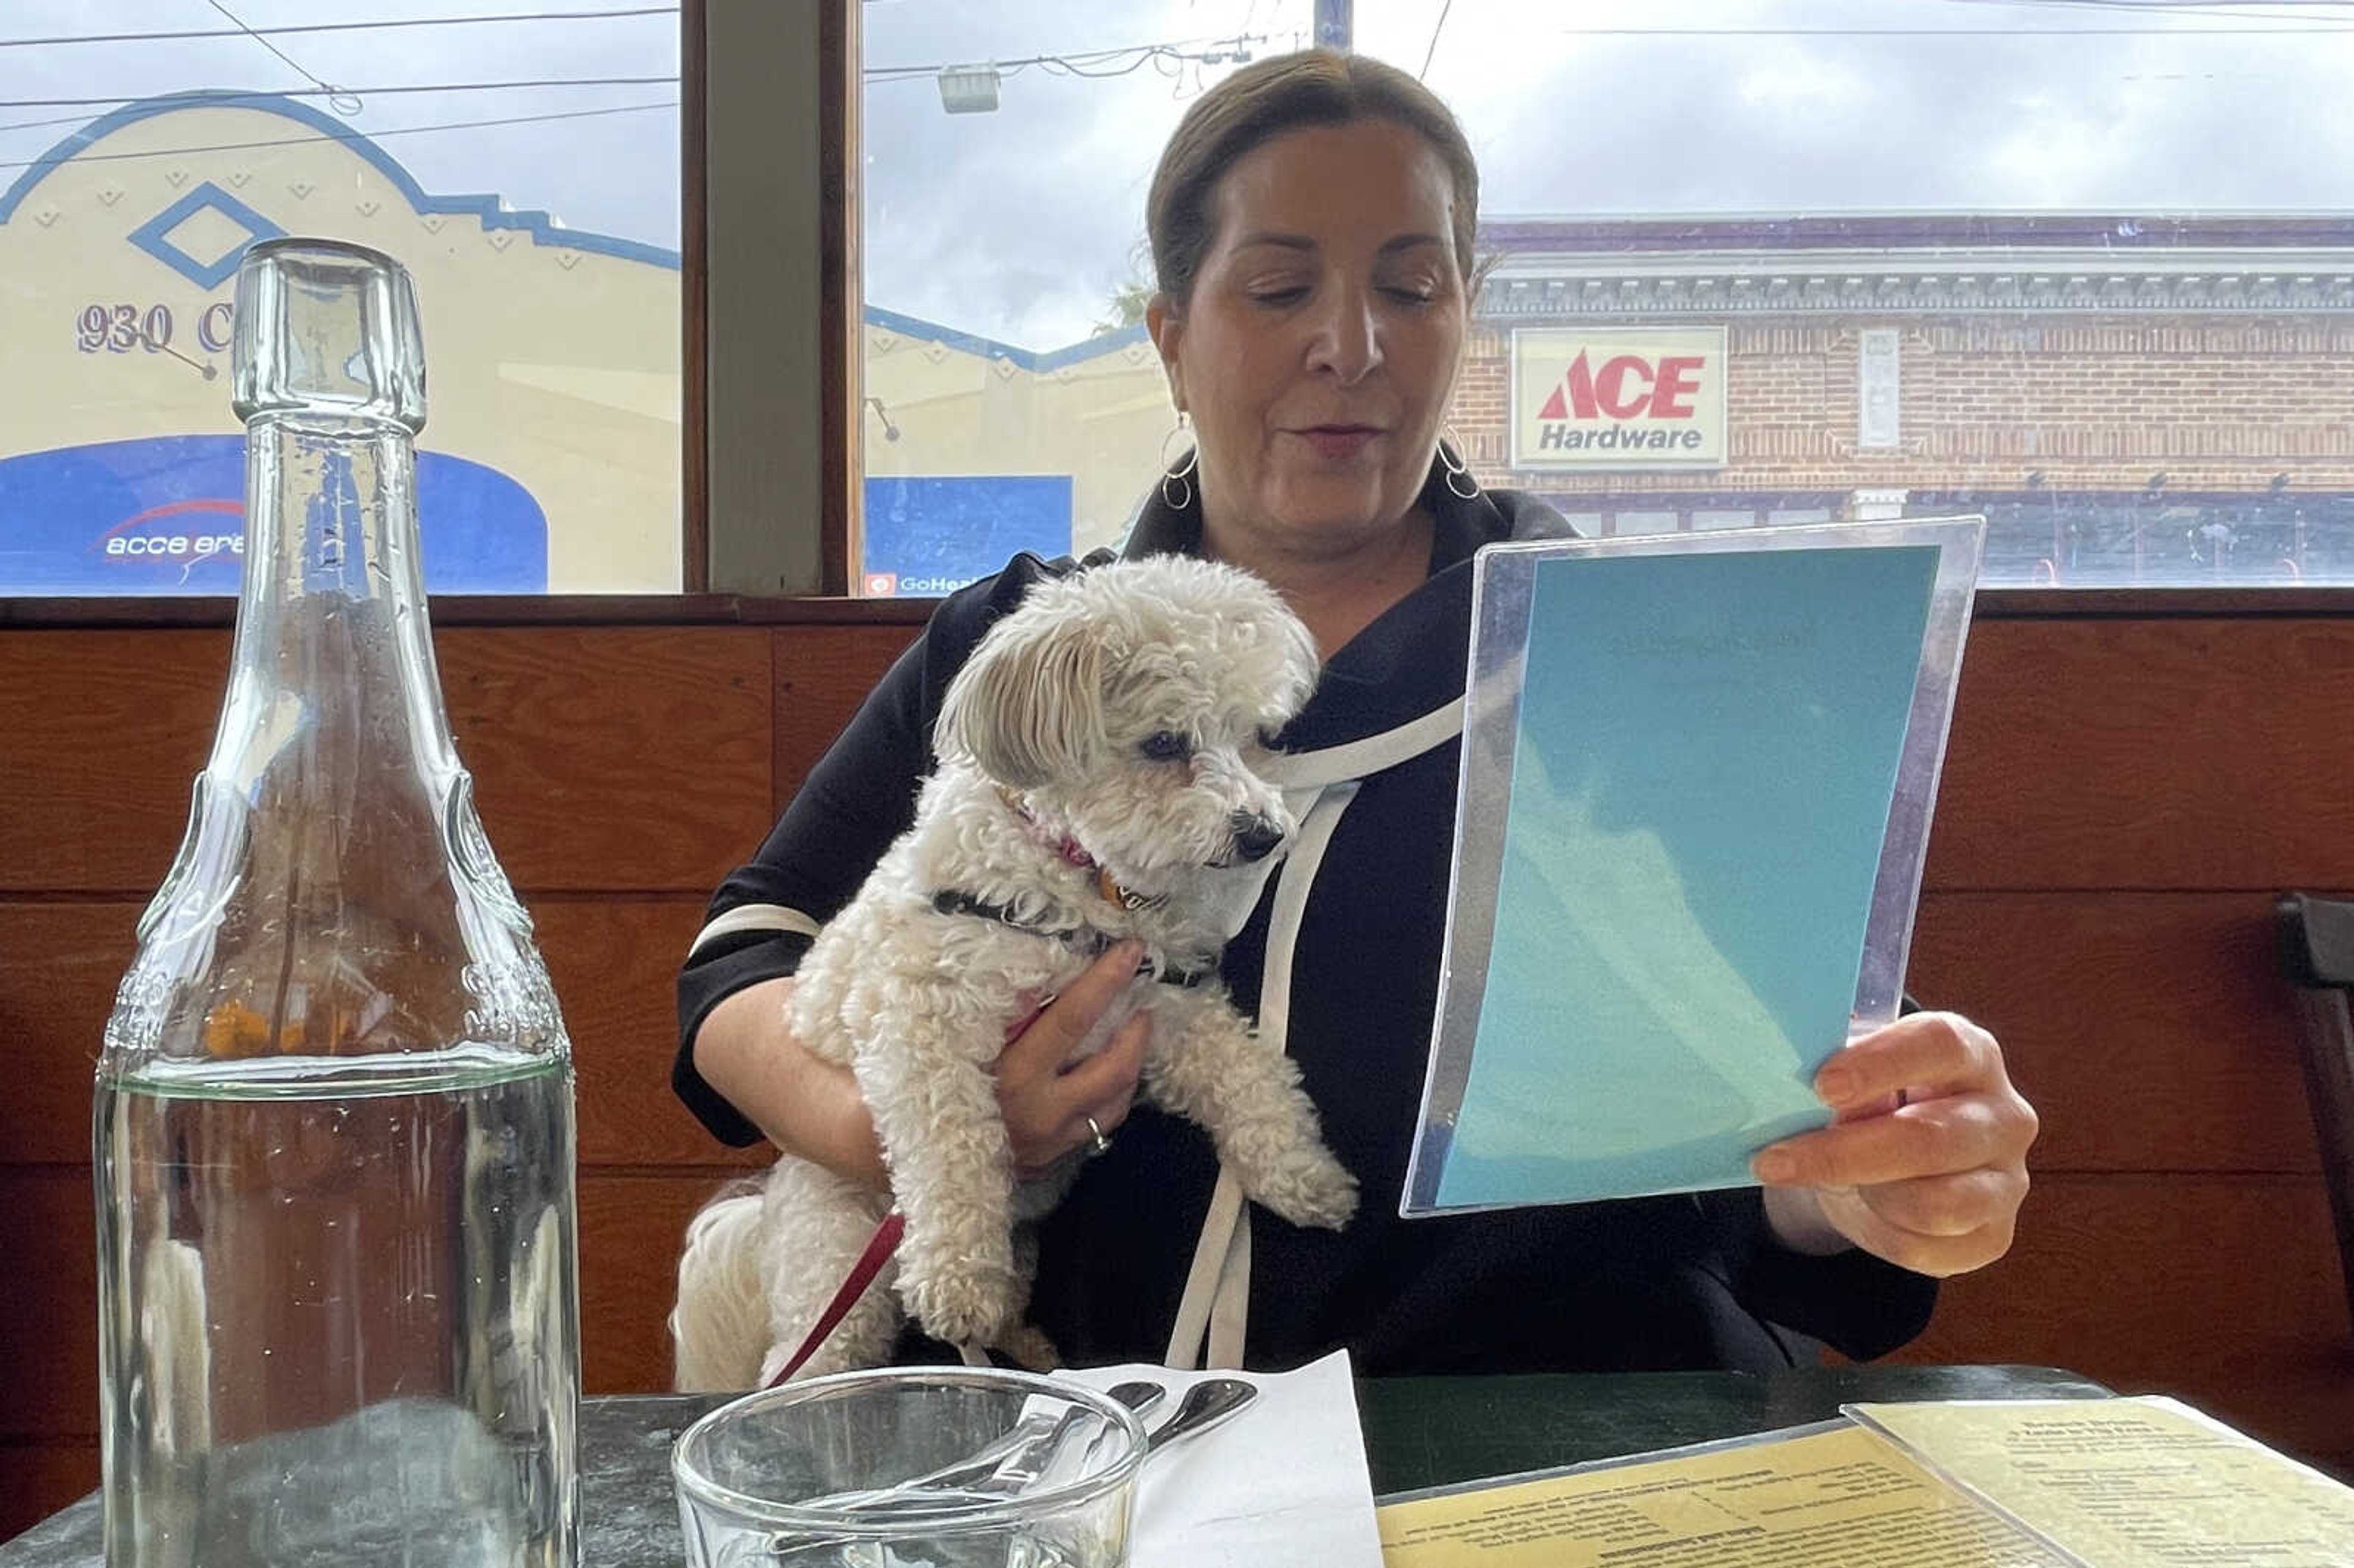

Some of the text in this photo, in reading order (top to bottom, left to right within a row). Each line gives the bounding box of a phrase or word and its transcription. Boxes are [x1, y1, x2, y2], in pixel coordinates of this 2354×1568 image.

[77, 304, 173, 354] 930
[1537, 346, 1705, 419] ACE
[1539, 423, 1702, 450] Hardware
